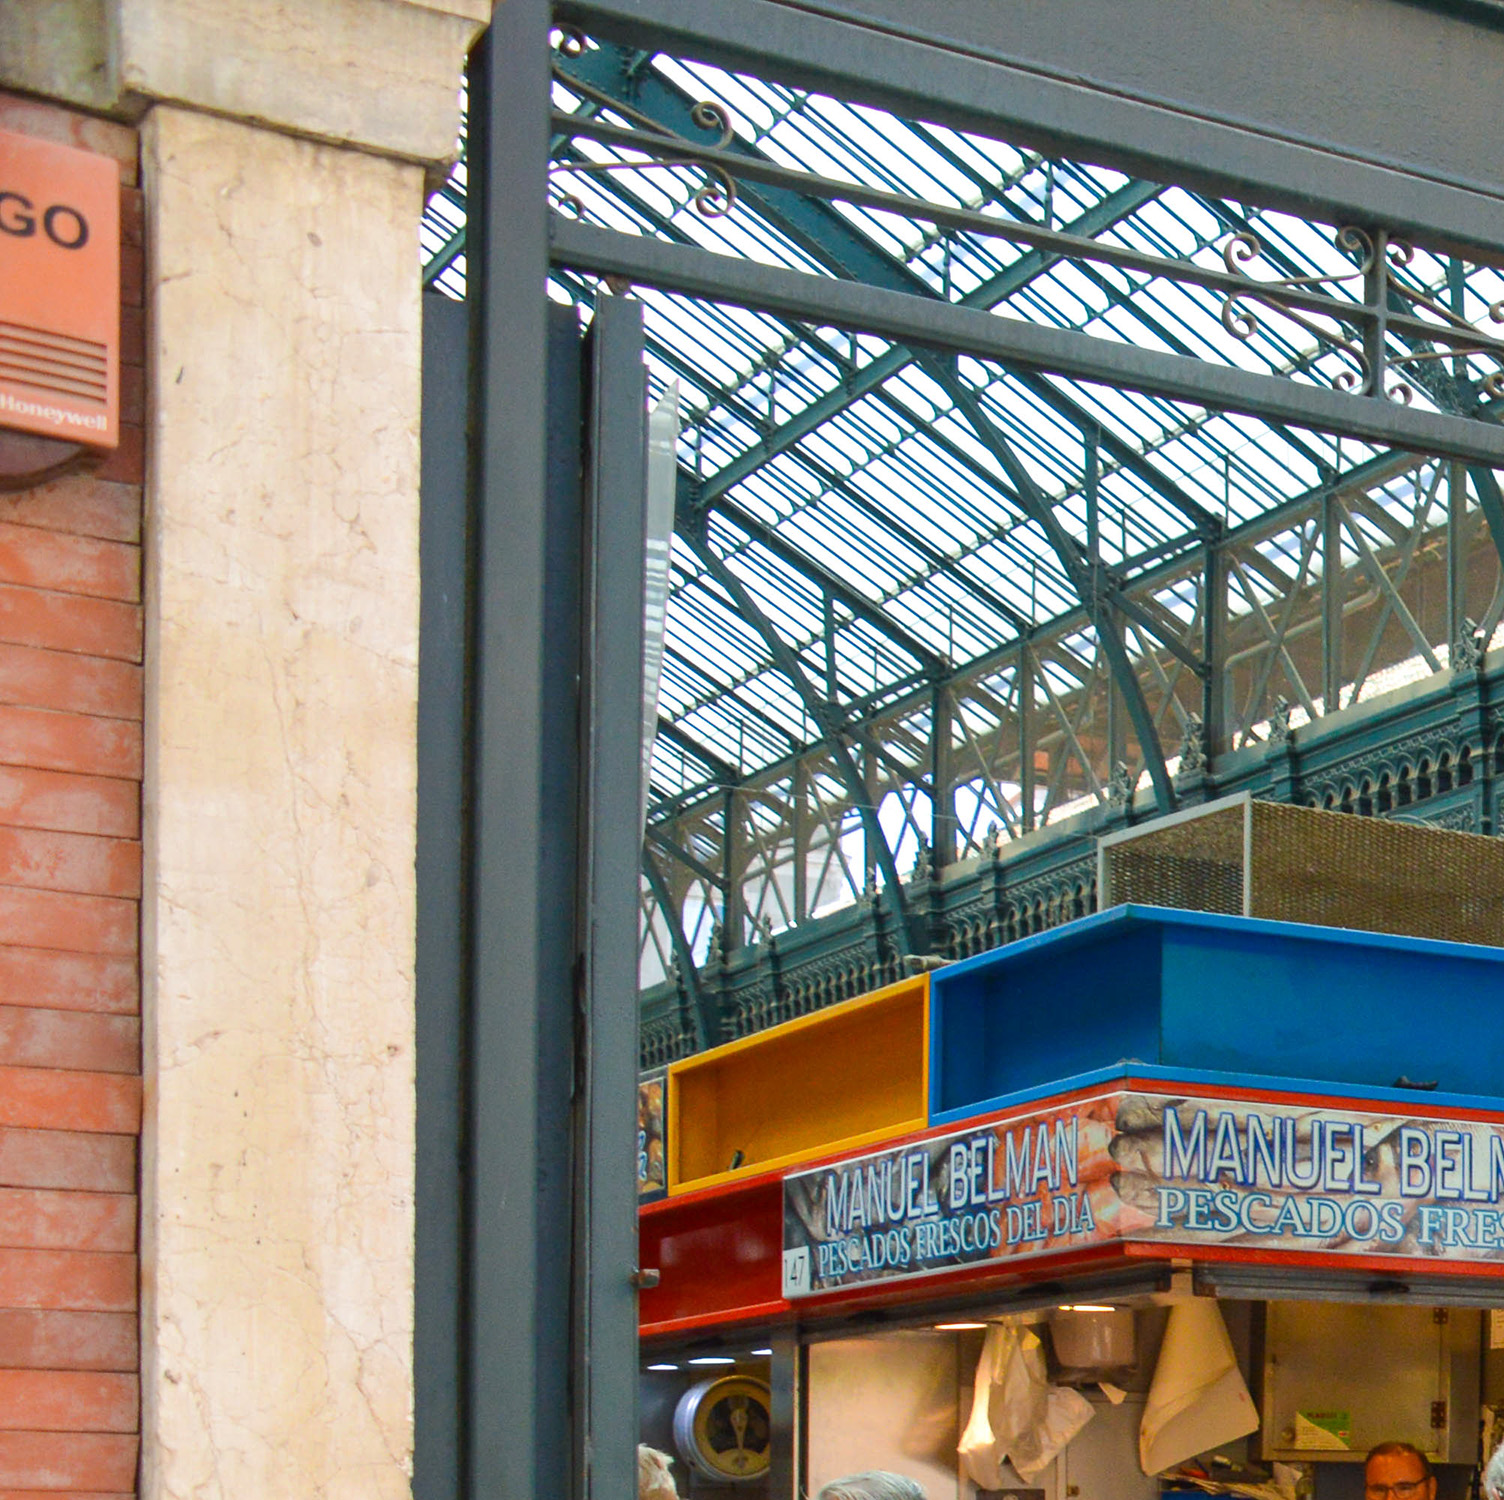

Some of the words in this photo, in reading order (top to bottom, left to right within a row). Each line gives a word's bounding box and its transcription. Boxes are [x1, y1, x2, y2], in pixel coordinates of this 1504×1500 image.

[0, 393, 107, 430] Honeywell
[826, 1151, 939, 1237] MANUEL
[949, 1115, 1079, 1211] BELMAN
[1162, 1106, 1382, 1195] MANUEL
[817, 1227, 910, 1280] PESCADOS
[915, 1208, 1001, 1261] FRESCOS
[1005, 1201, 1048, 1246] DEL
[1052, 1190, 1096, 1237] DIA
[1155, 1185, 1403, 1243] PESCADOS
[784, 1256, 805, 1288] 147
